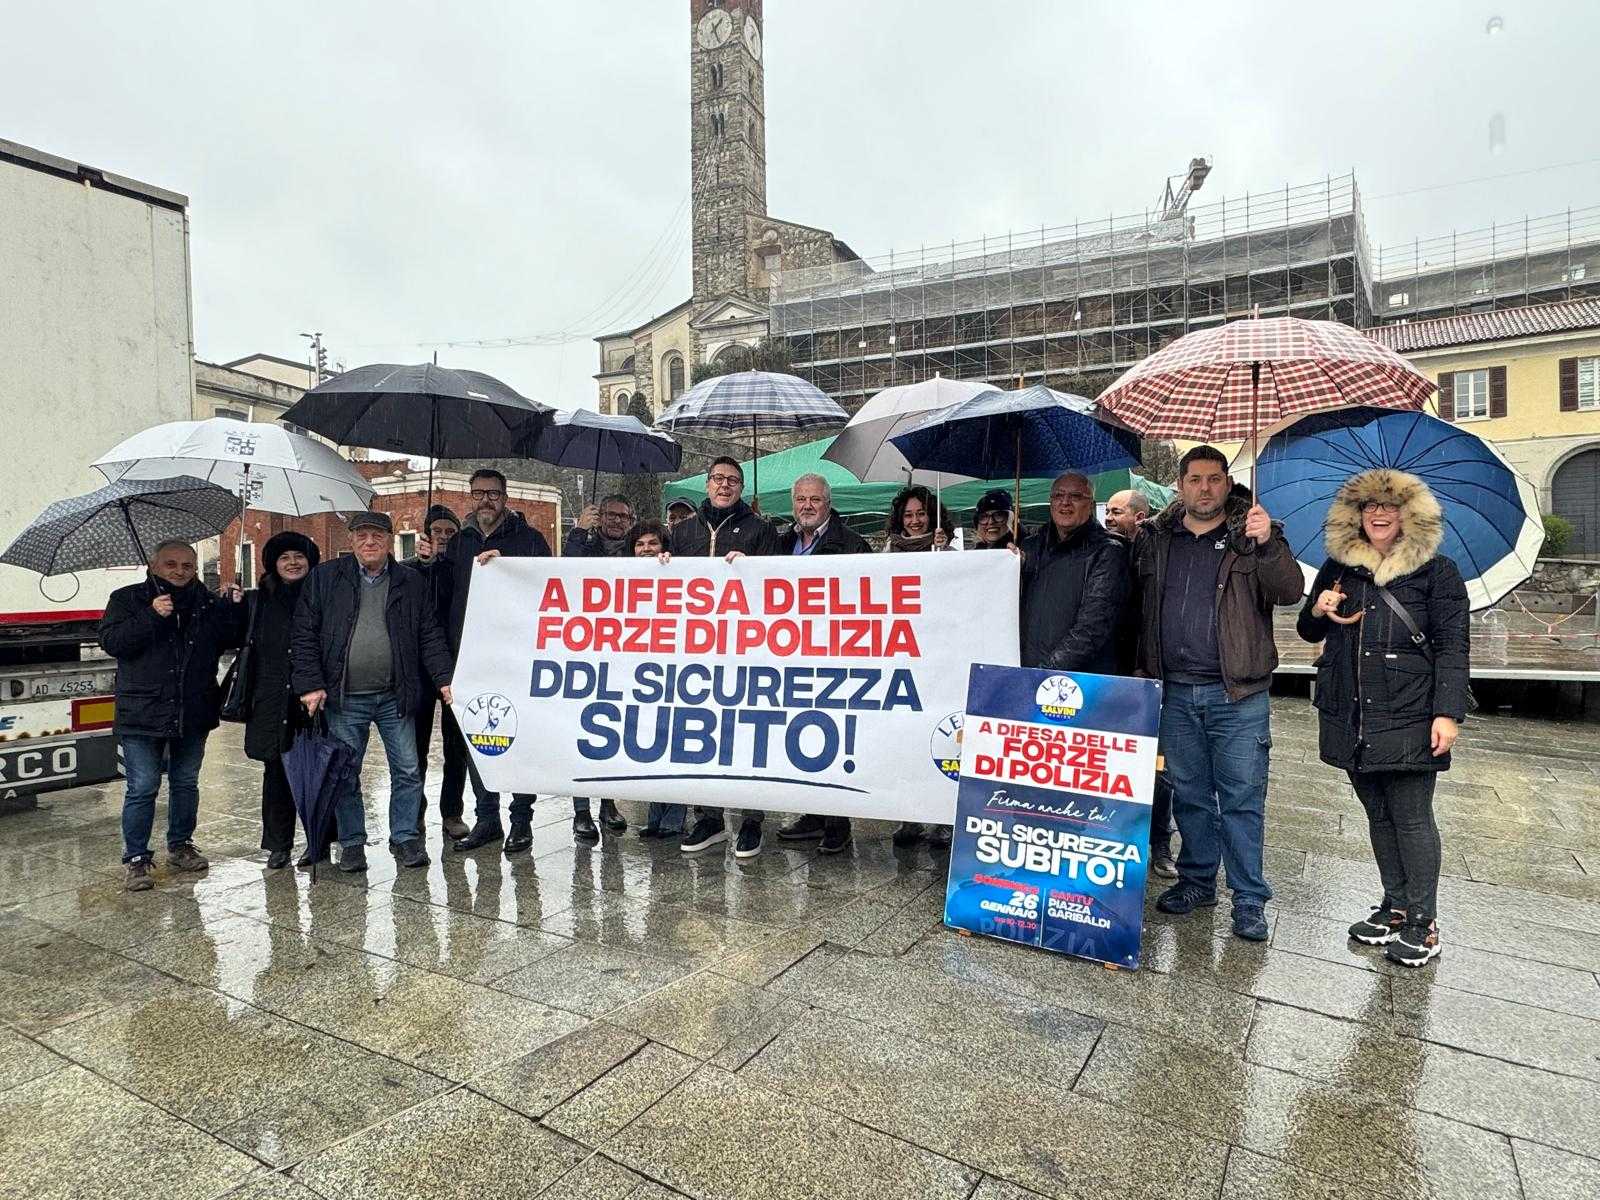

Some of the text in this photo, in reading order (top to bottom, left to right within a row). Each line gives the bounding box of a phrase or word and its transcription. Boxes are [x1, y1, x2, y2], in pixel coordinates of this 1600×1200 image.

[538, 575, 921, 616] A DIFESA DELLE
[536, 615, 921, 658] FORZE DI POLIZIA
[35, 680, 94, 696] AD 45253
[529, 659, 923, 712] DDL SICUREZZA
[1041, 678, 1077, 694] LEGA
[468, 695, 511, 718] LEGA
[1041, 704, 1077, 717] SALVINI
[471, 734, 510, 747] SALVINI
[576, 701, 857, 774] SUBITO!
[978, 720, 1138, 753] A DIFESA DELLE
[1003, 736, 1108, 771] FORZE
[974, 754, 1004, 777] DI
[1009, 759, 1134, 797] POLIZIA
[1037, 800, 1085, 817] anche
[965, 816, 1142, 864] DDL SICUREZZA
[975, 835, 1126, 889] SUBITO!
[979, 900, 1038, 920] GENNAIO
[1008, 891, 1040, 910] 26
[1048, 897, 1092, 916] PIAZZA
[1047, 908, 1111, 930] GARIBALDI
